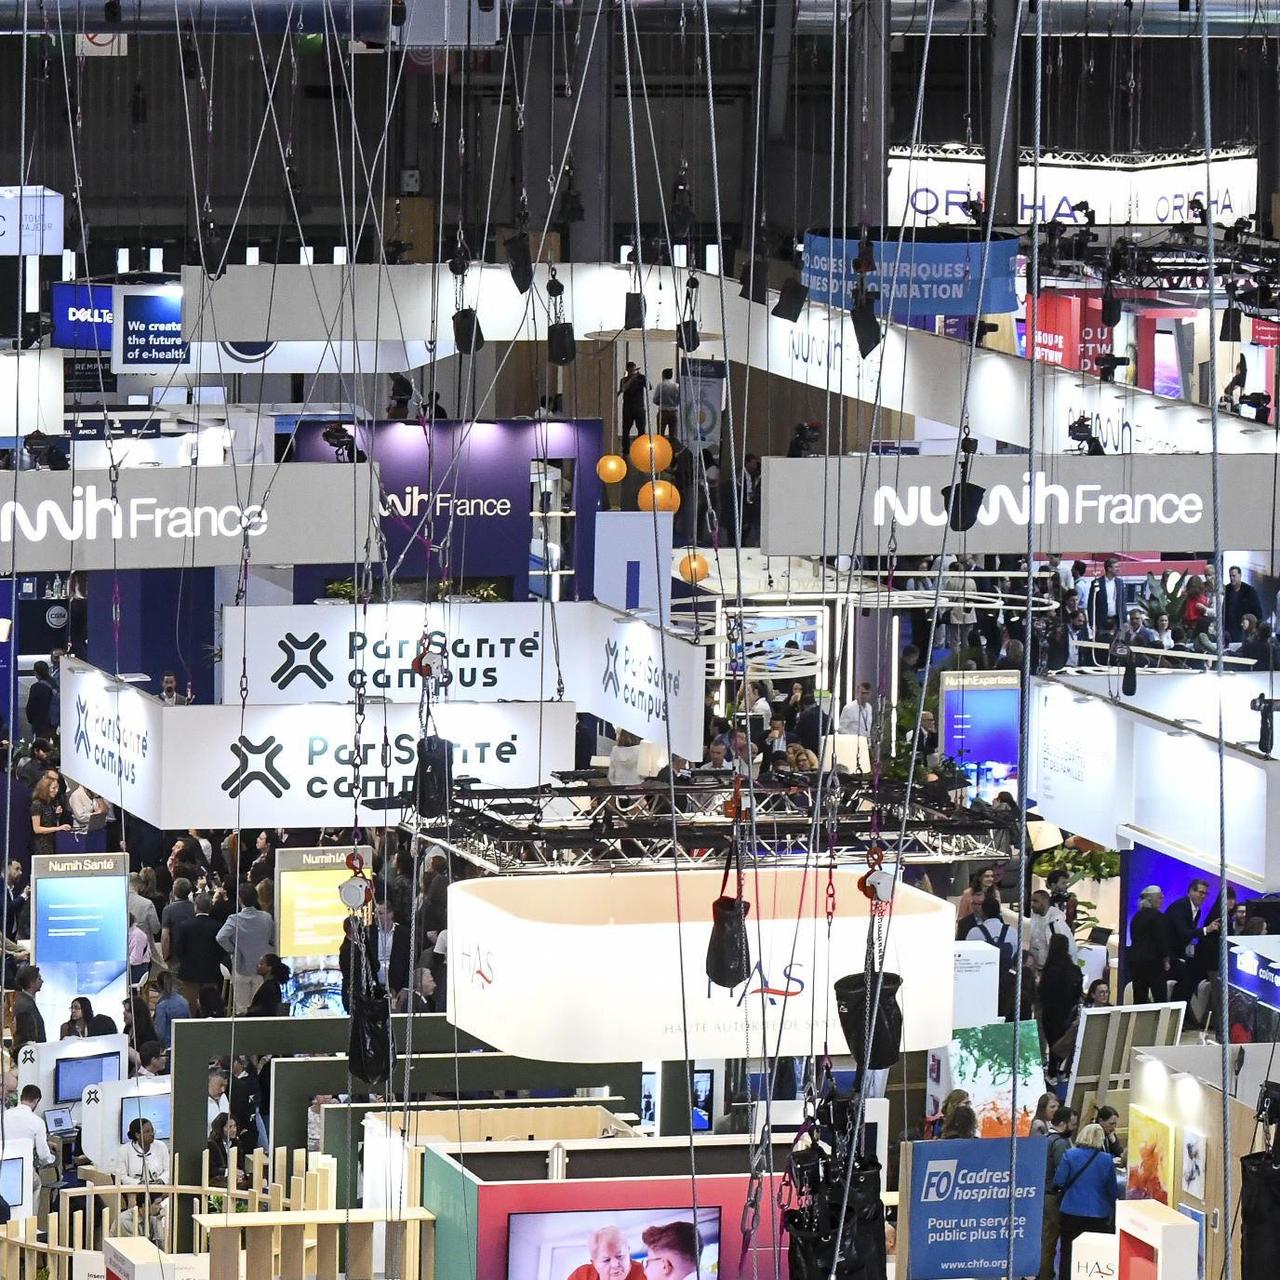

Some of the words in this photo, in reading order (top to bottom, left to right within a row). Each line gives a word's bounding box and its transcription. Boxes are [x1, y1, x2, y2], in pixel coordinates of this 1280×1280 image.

[127, 321, 146, 332] We
[148, 321, 183, 332] create
[127, 335, 146, 346] the
[148, 335, 183, 346] future
[127, 349, 140, 360] of
[141, 349, 187, 360] e-health
[436, 493, 511, 517] France
[1076, 484, 1204, 526] France
[129, 497, 269, 538] France
[306, 733, 518, 767] PariSté
[923, 1170, 954, 1200] FO
[956, 1168, 1010, 1185] Cadres
[927, 1217, 958, 1229] Pour
[959, 1218, 977, 1229] un
[927, 1229, 967, 1244] public
[969, 1228, 997, 1243] plus
[940, 1258, 1009, 1271] www.chfo.org
[1077, 1260, 1115, 1278] HAS
